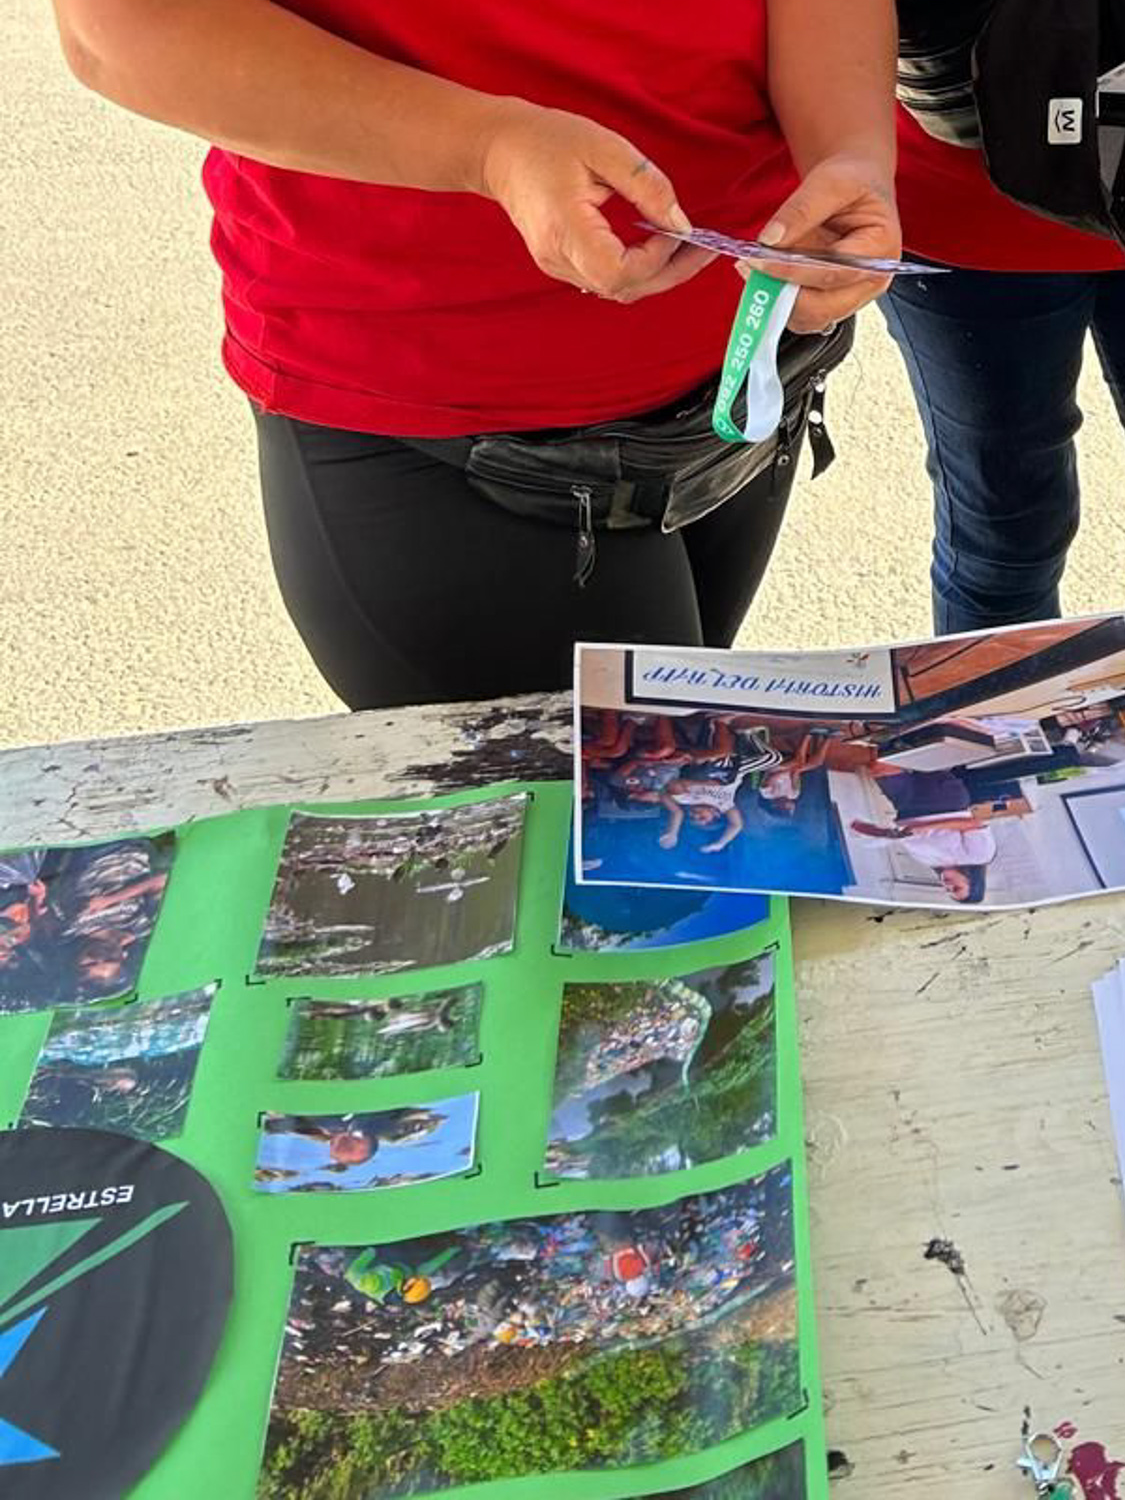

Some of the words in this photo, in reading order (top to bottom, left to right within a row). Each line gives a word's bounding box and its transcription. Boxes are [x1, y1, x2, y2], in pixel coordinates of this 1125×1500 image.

[731, 333, 754, 370] 250
[746, 289, 770, 330] 260
[709, 666, 760, 691] DEL
[764, 676, 882, 700] HISTORIA
[2, 1184, 136, 1219] ESTRELLA
